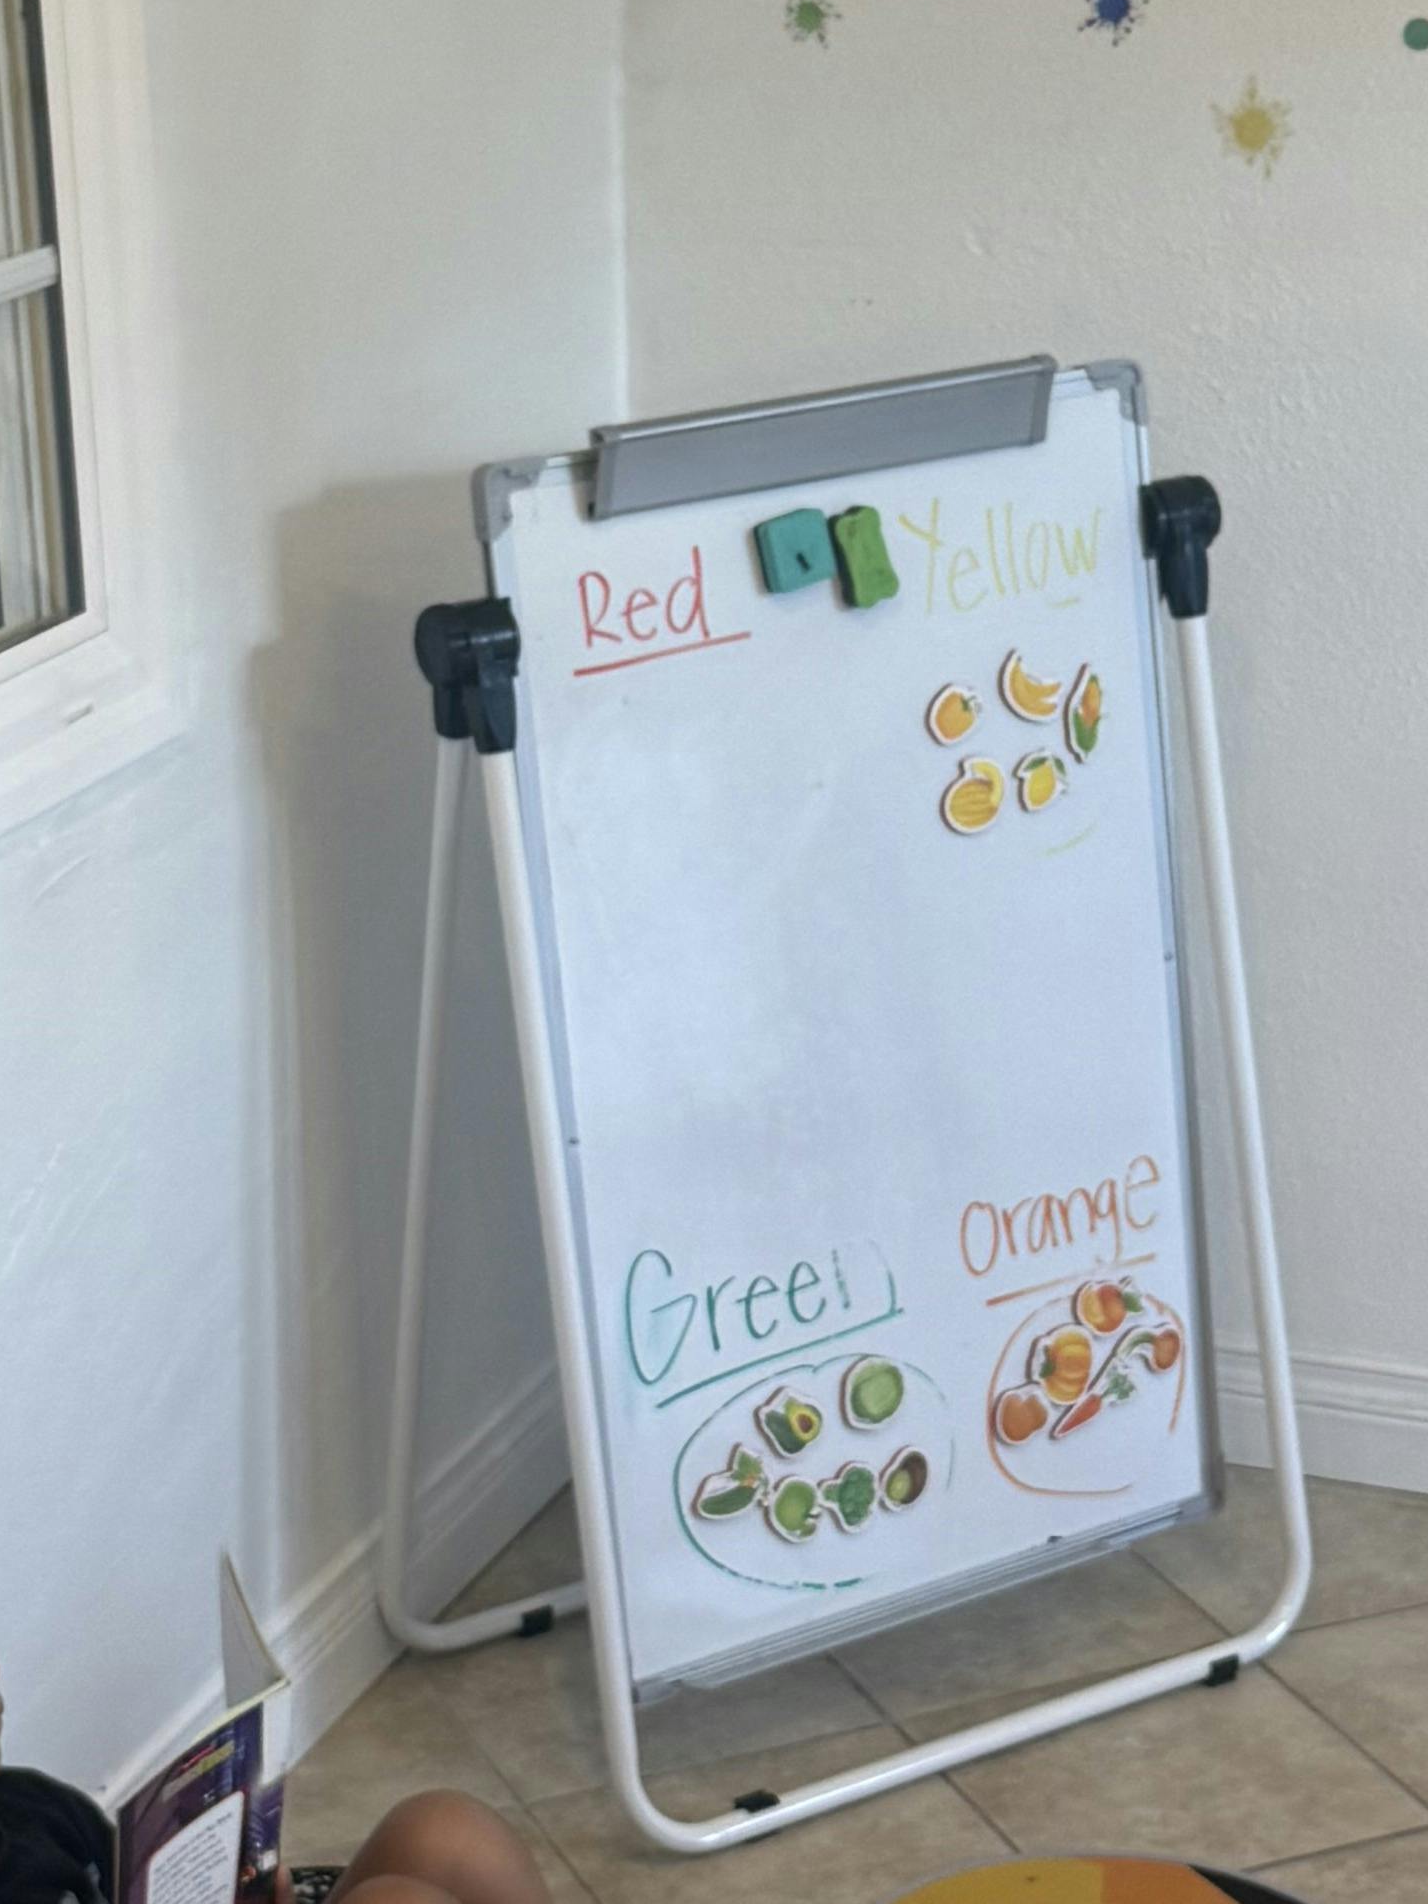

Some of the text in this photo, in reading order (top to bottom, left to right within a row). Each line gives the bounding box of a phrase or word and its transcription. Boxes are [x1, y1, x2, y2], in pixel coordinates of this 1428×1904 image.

[577, 545, 712, 649] Red
[899, 498, 1102, 615] Yellow
[959, 1154, 1162, 1278] Orange
